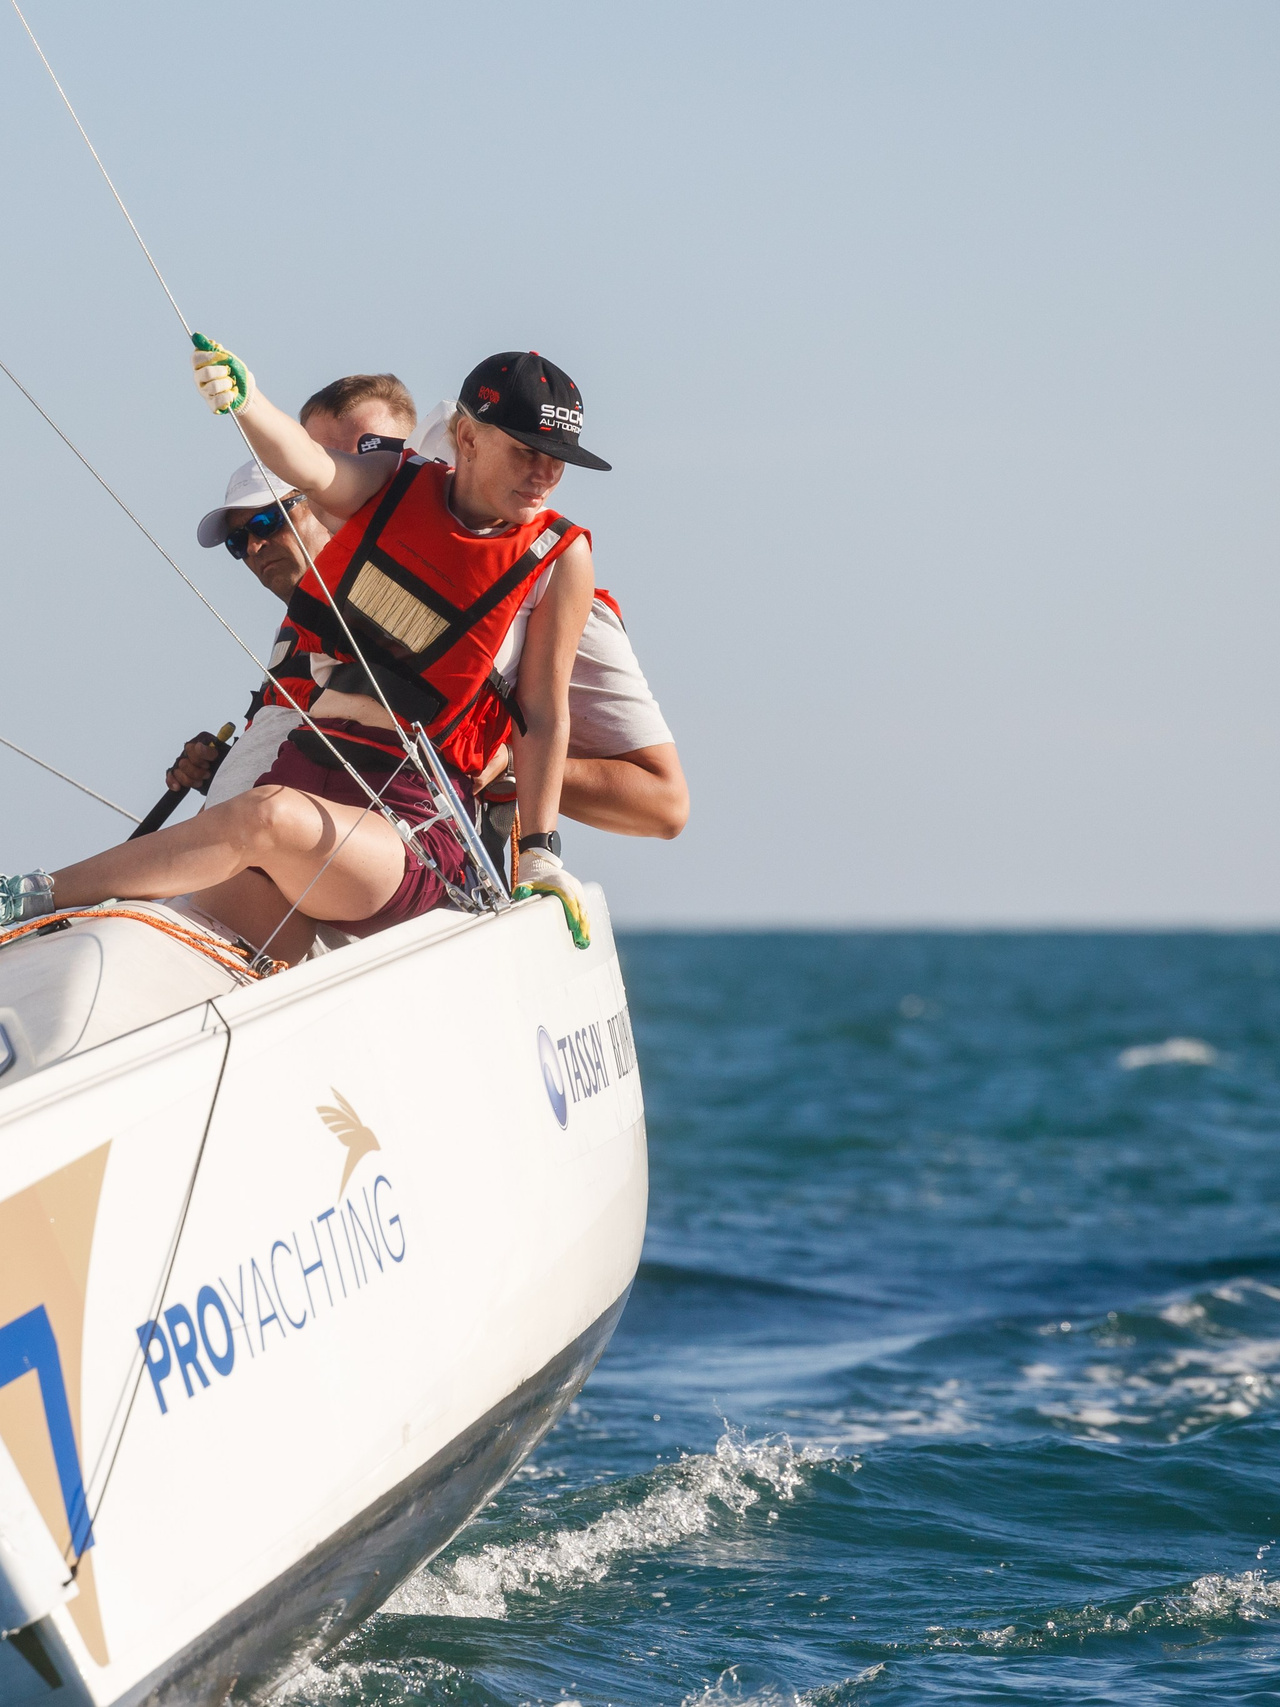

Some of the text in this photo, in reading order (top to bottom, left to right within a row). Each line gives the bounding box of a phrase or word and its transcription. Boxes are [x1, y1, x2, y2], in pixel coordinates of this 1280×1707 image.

[541, 404, 583, 427] SOCH
[557, 1021, 610, 1104] TASSAY
[136, 1175, 406, 1415] PROYACHTING
